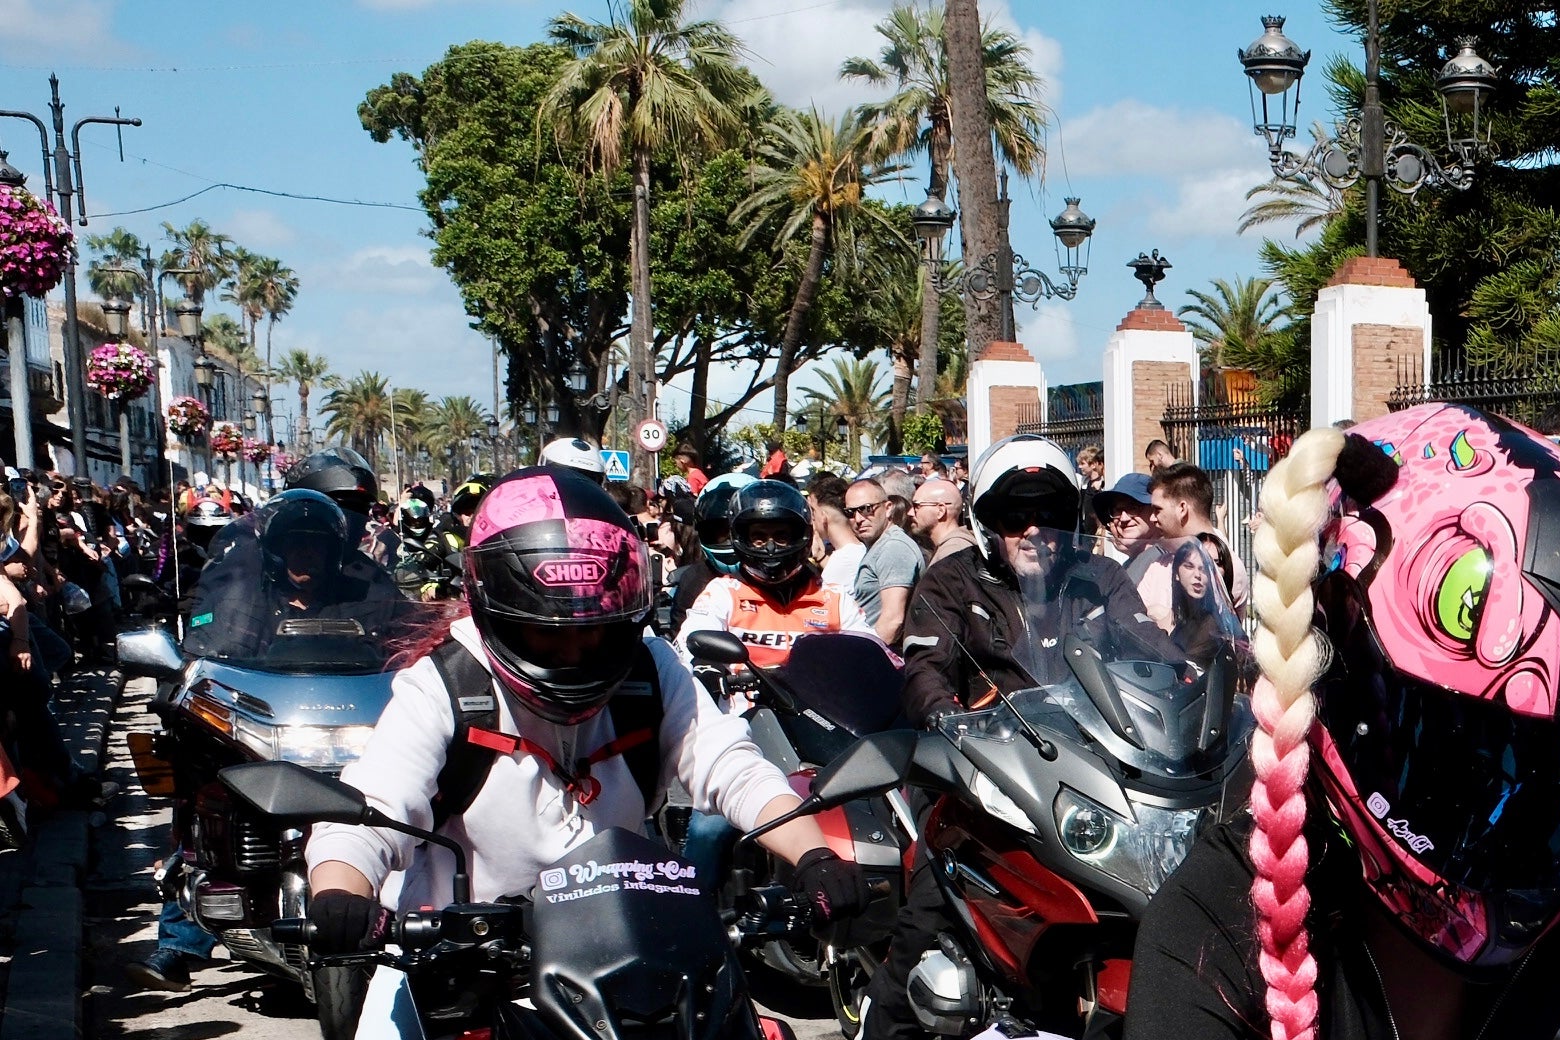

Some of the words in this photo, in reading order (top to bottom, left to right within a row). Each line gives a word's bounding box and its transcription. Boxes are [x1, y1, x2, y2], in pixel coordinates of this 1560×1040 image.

[643, 430, 660, 439] 30
[544, 564, 598, 581] SHOEI
[546, 883, 620, 904] Vinilados
[623, 880, 700, 896] integrales
